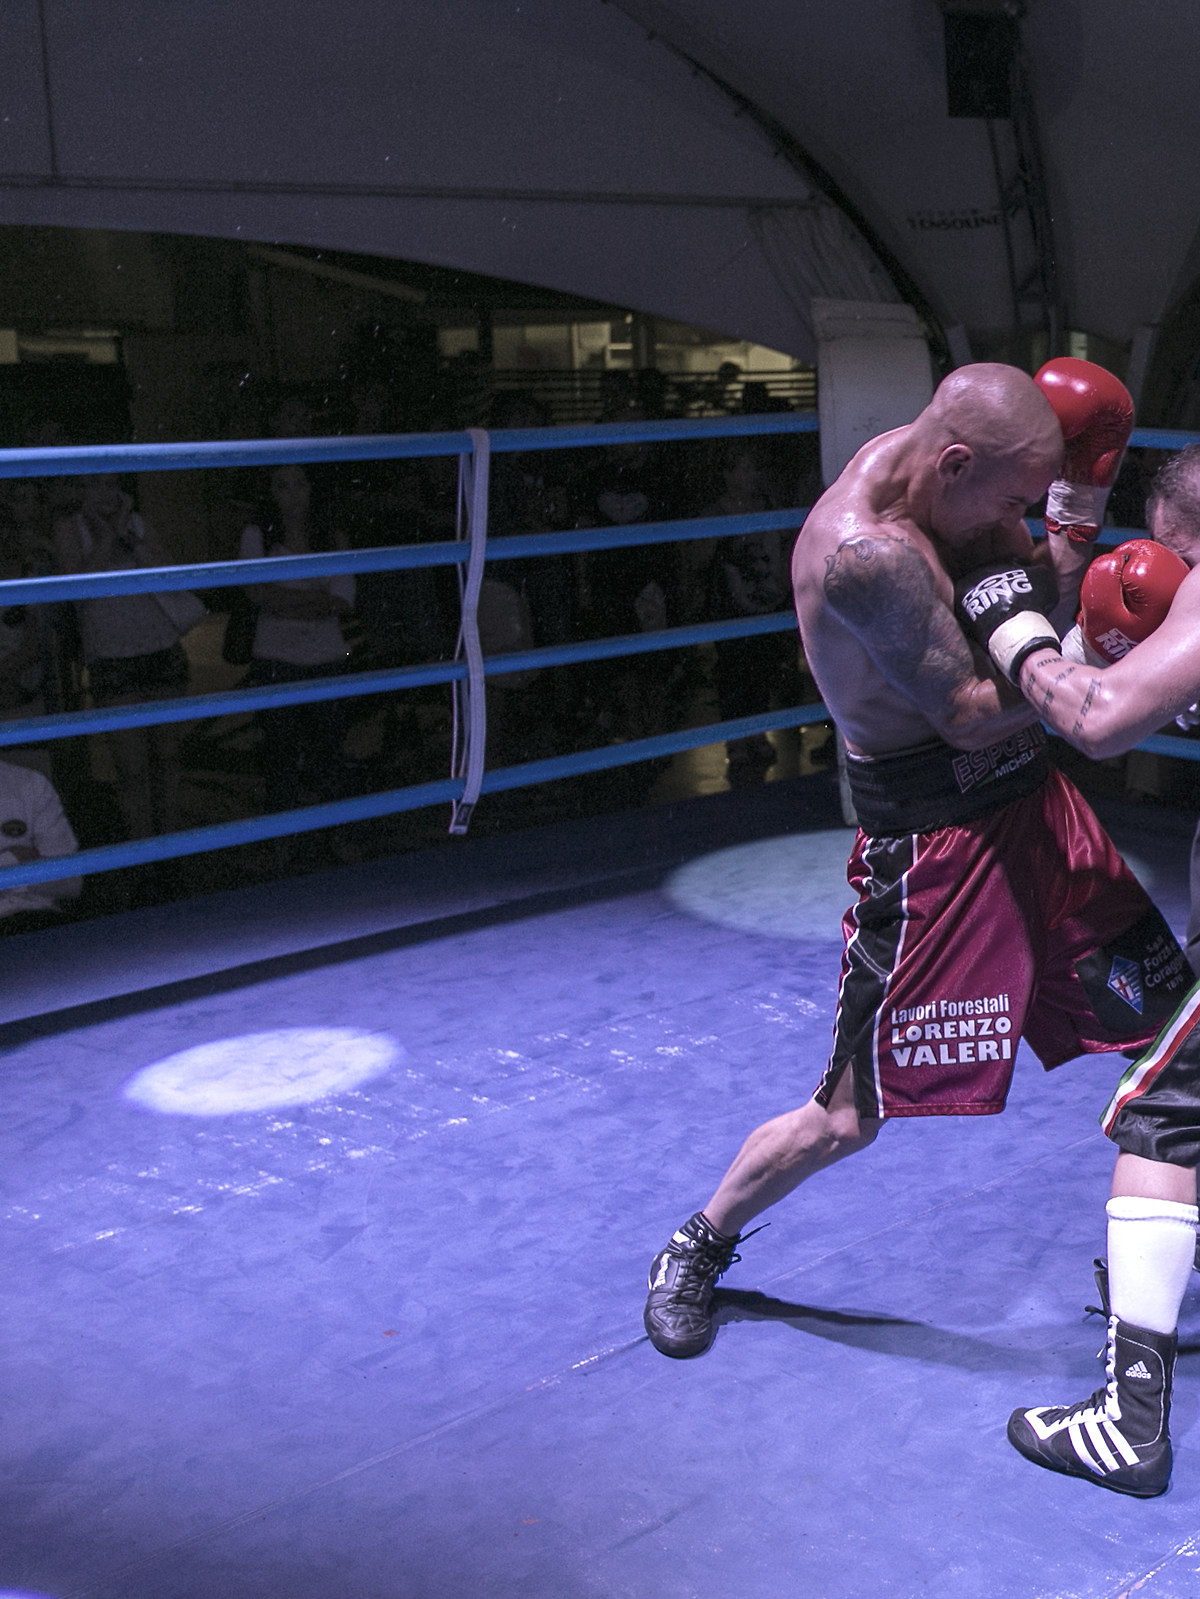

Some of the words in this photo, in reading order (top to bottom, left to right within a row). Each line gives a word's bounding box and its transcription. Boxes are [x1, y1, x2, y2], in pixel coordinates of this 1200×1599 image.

[966, 578, 1033, 622] RING
[995, 748, 1036, 778] MICHELE
[891, 1001, 937, 1025] Lavori
[941, 993, 1010, 1018] Forestali
[891, 1016, 1012, 1044] LORENZO
[891, 1038, 1012, 1068] VALERI
[1124, 1370, 1152, 1379] adidas
